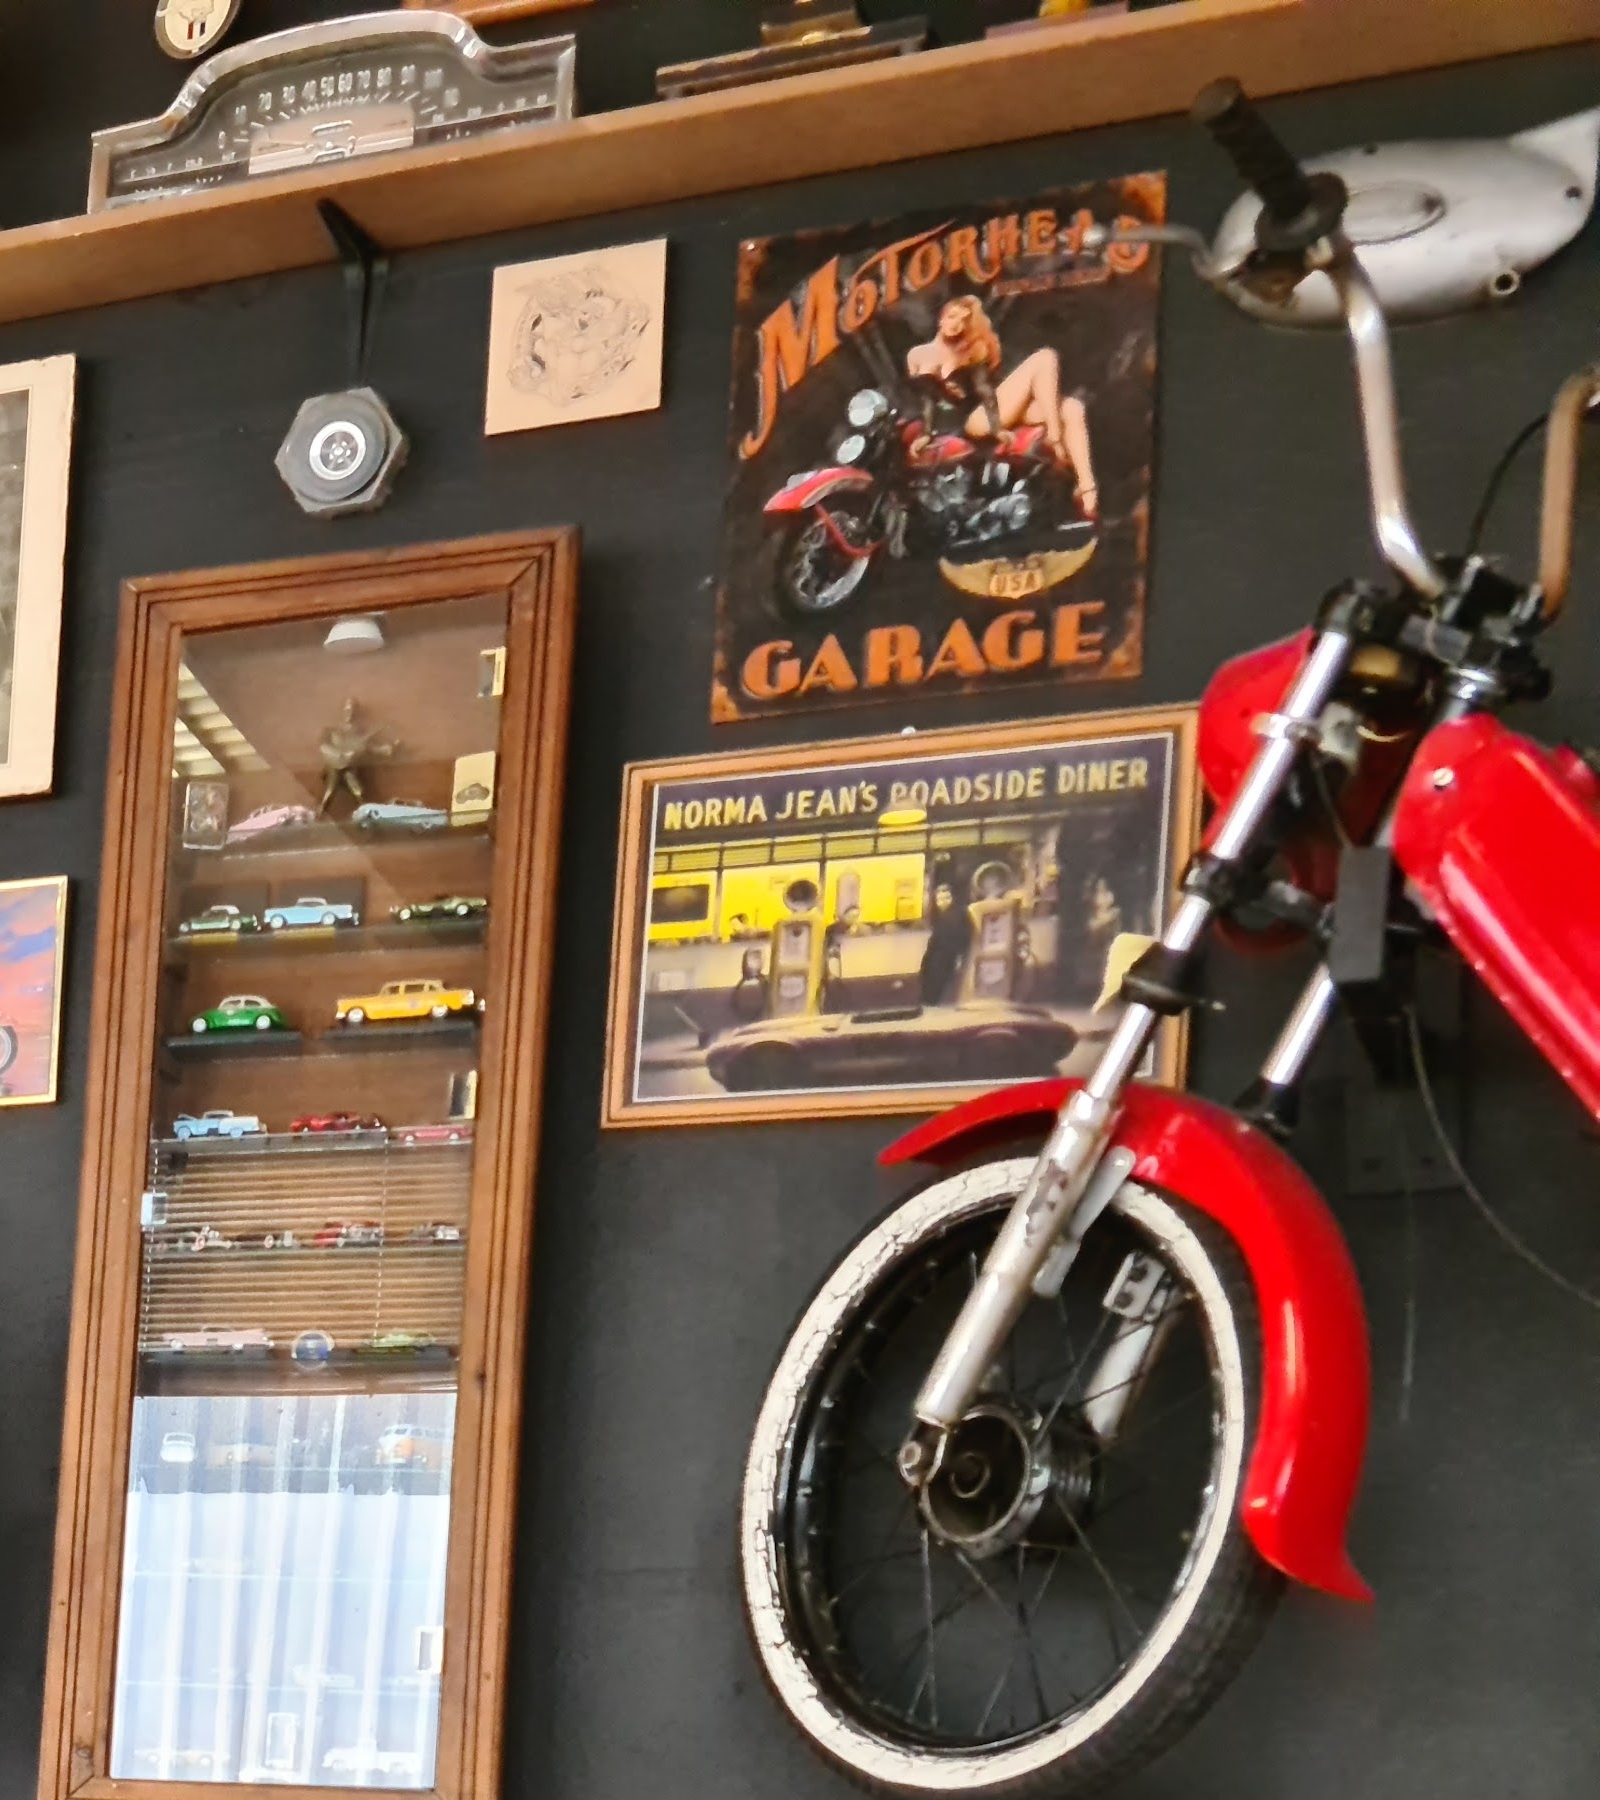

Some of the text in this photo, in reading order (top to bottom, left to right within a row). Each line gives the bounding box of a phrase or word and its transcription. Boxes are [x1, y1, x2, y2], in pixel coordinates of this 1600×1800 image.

[259, 92, 273, 112] 20
[282, 86, 296, 104] 30
[320, 76, 335, 97] 50
[338, 73, 353, 93] 60
[357, 70, 371, 89] 70
[991, 569, 1043, 595] USA
[741, 600, 1106, 699] GARAGE
[663, 793, 767, 832] NORMA
[774, 780, 879, 821] JEAN'S
[1057, 757, 1150, 795] DINER
